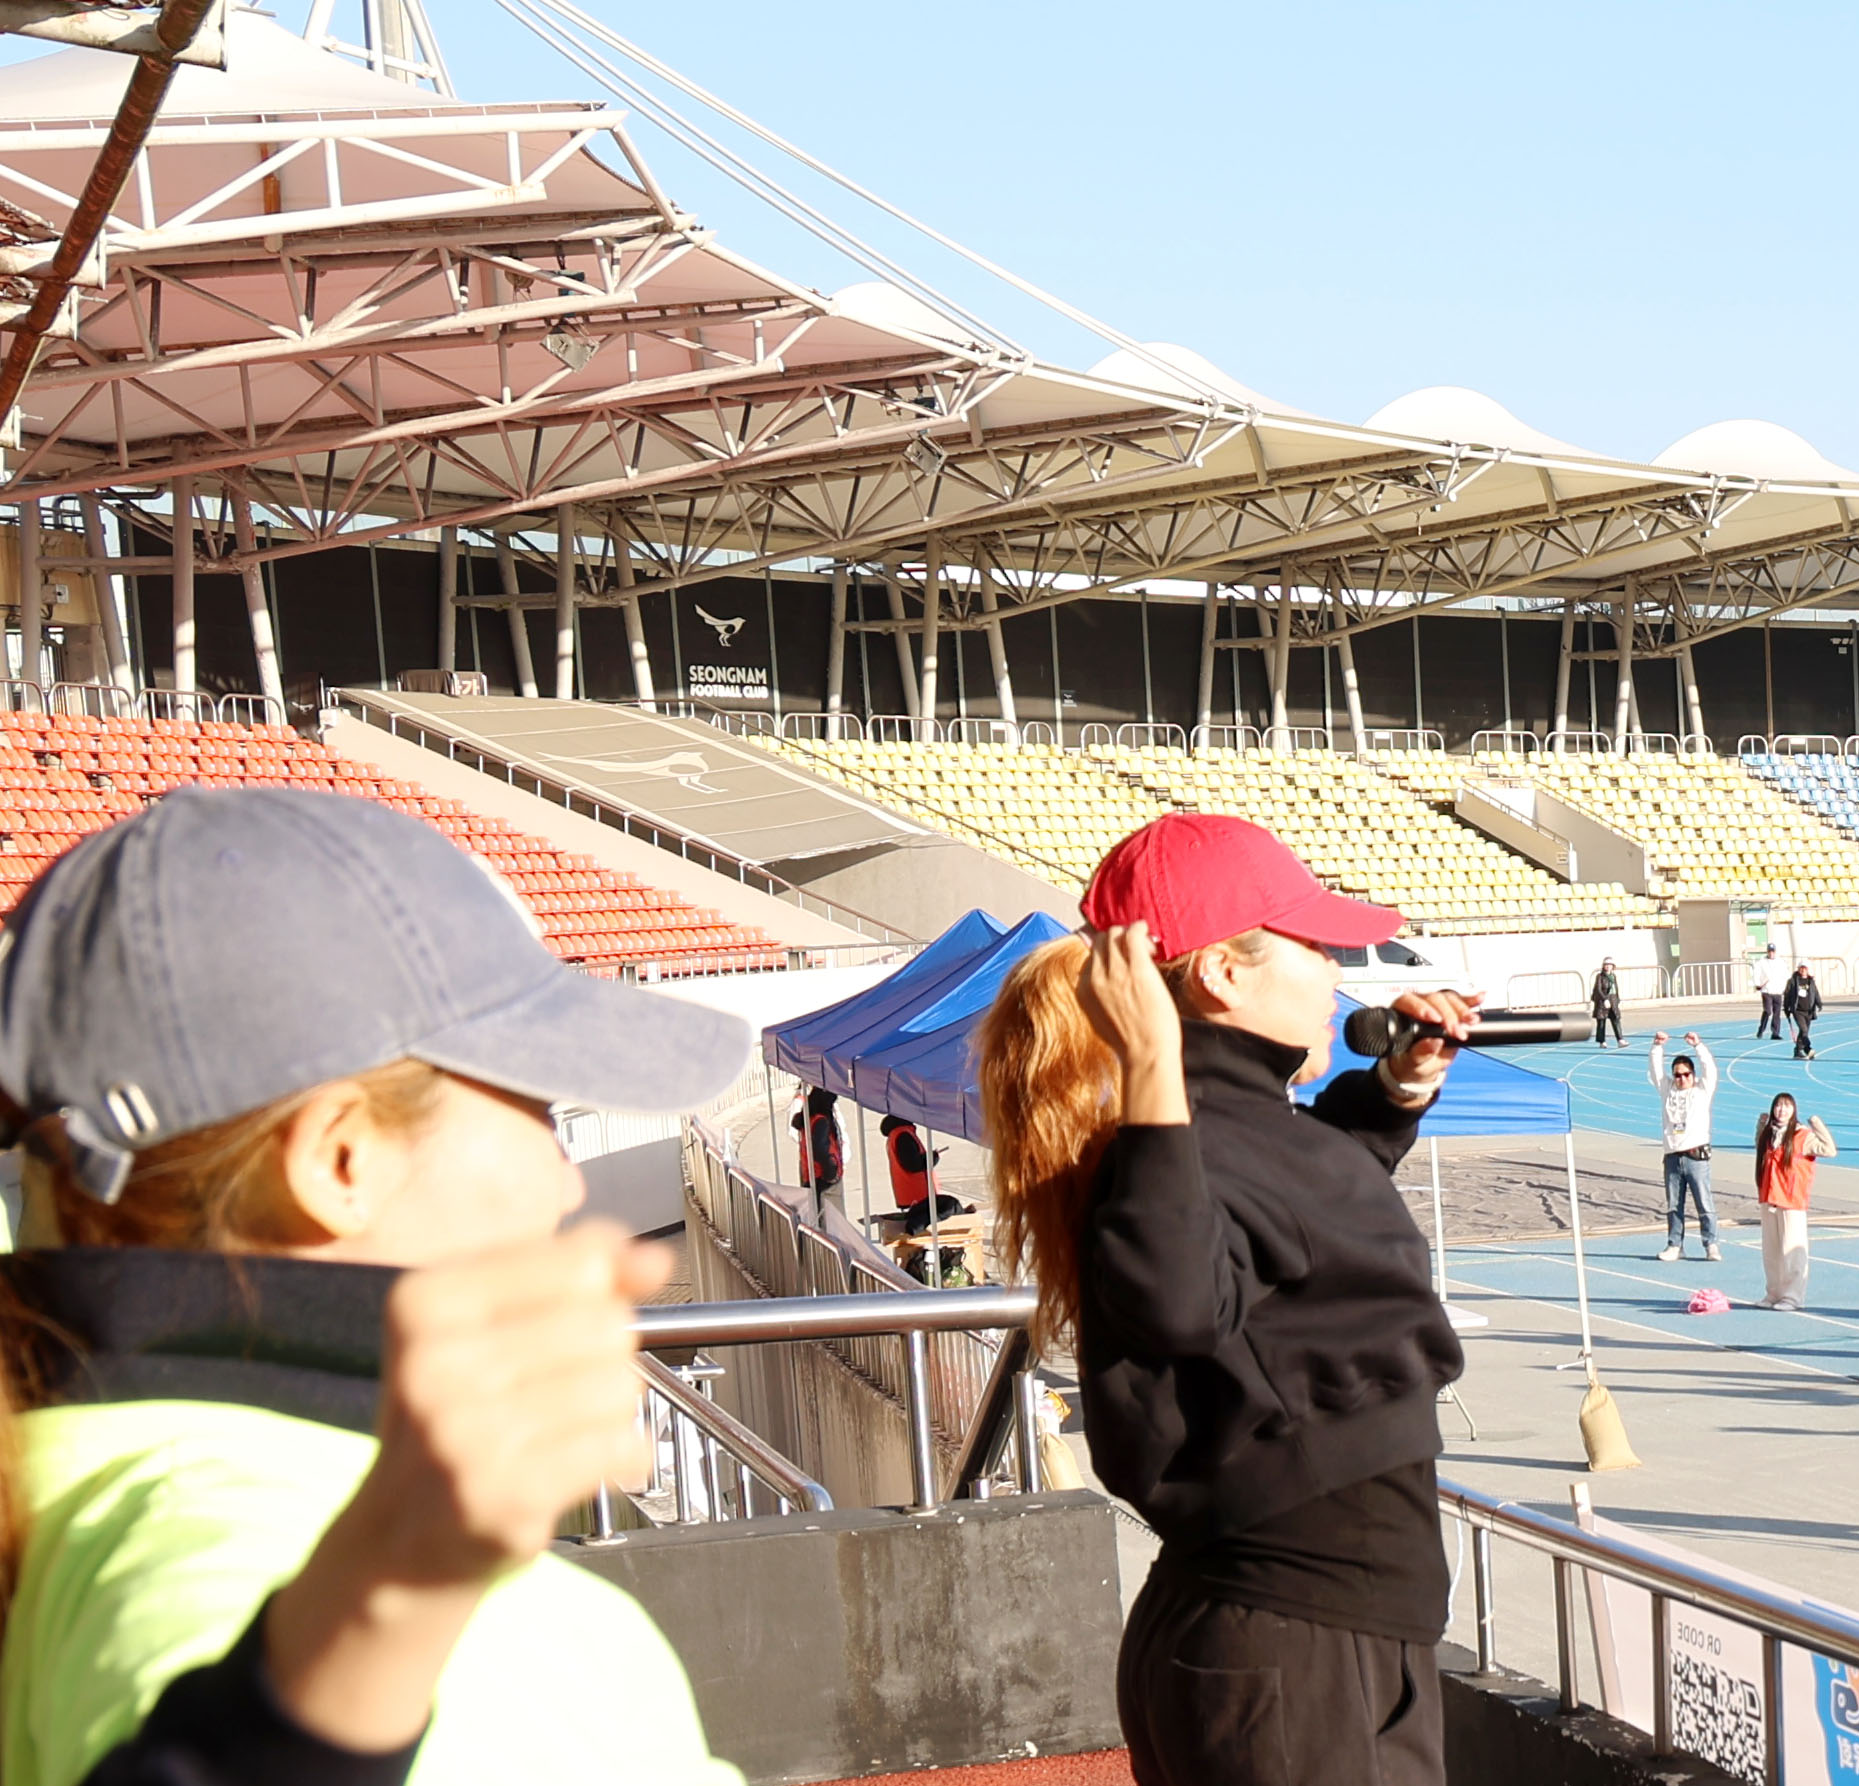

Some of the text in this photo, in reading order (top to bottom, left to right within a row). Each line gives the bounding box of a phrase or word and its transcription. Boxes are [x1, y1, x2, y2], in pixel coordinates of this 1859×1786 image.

[689, 665, 767, 684] SEONGNAM
[690, 684, 769, 698] FOOTBALL CLUB
